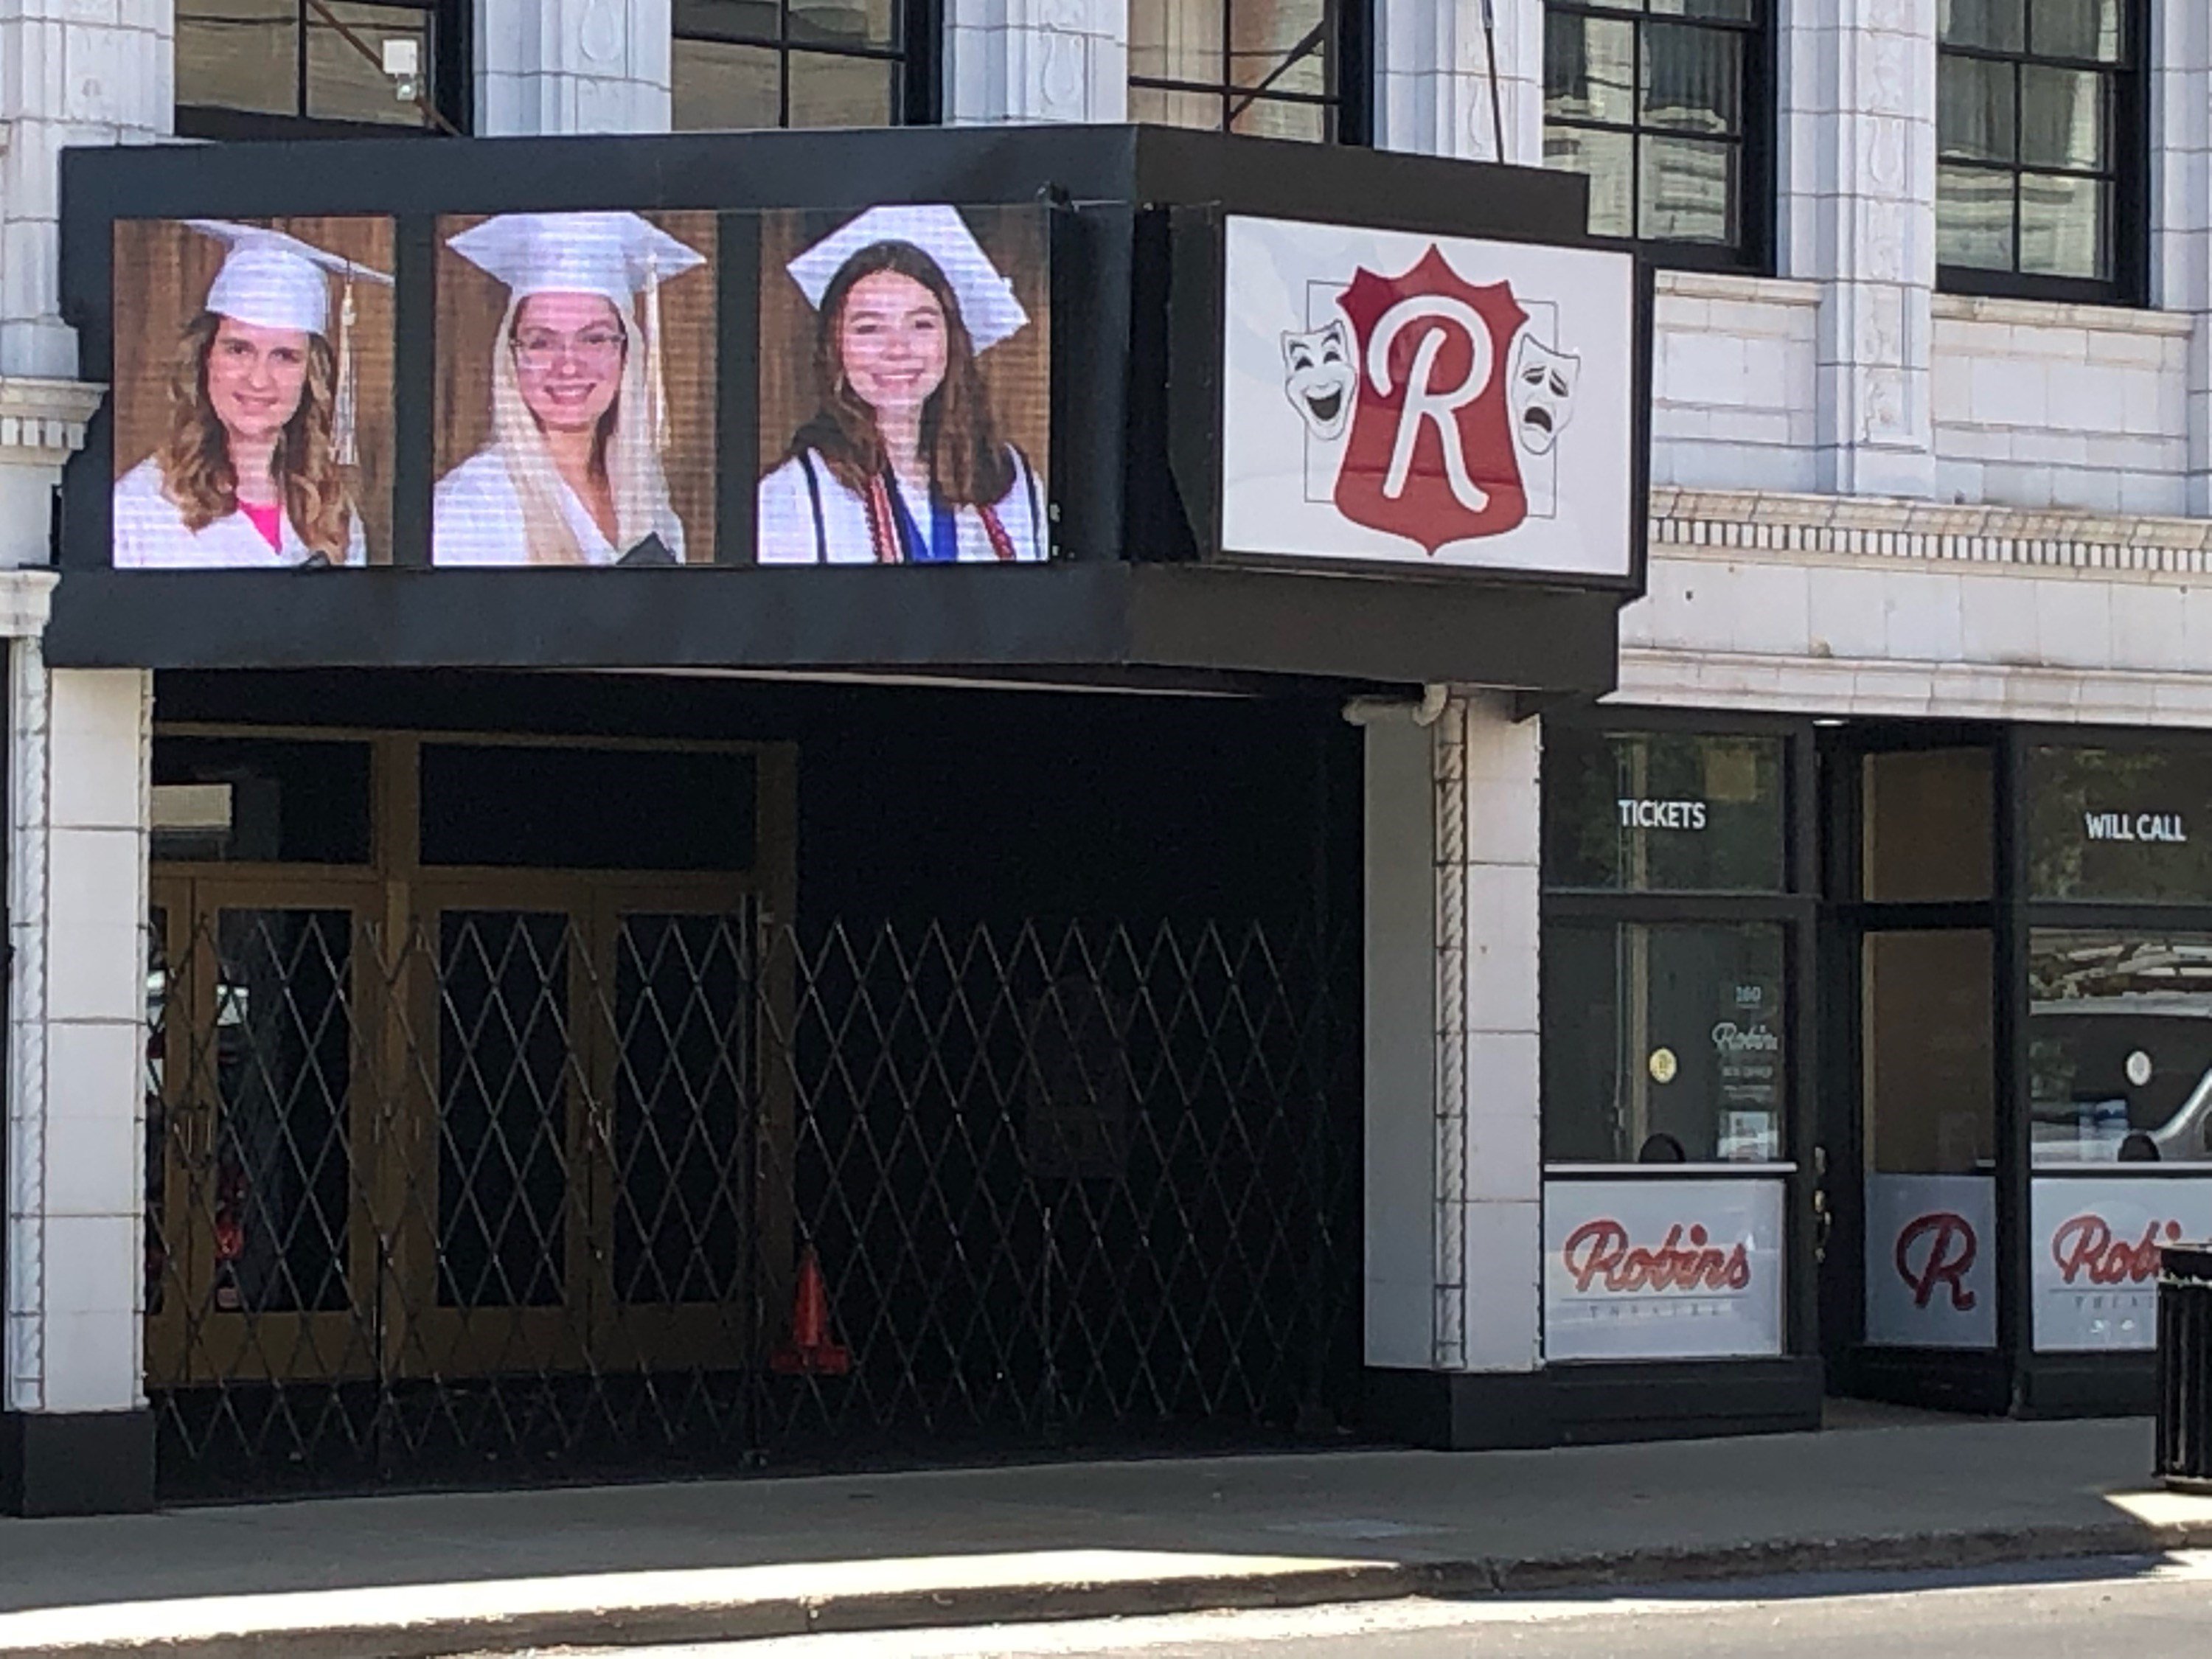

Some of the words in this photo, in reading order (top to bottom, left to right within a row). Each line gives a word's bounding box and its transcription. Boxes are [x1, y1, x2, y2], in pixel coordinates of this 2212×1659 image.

[1367, 294, 1494, 514] R
[1618, 799, 1706, 830] TICKETS
[2085, 811, 2134, 841] WILL
[2136, 813, 2187, 842] CALL
[1563, 1218, 1752, 1293] Robins
[1895, 1211, 1978, 1311] R
